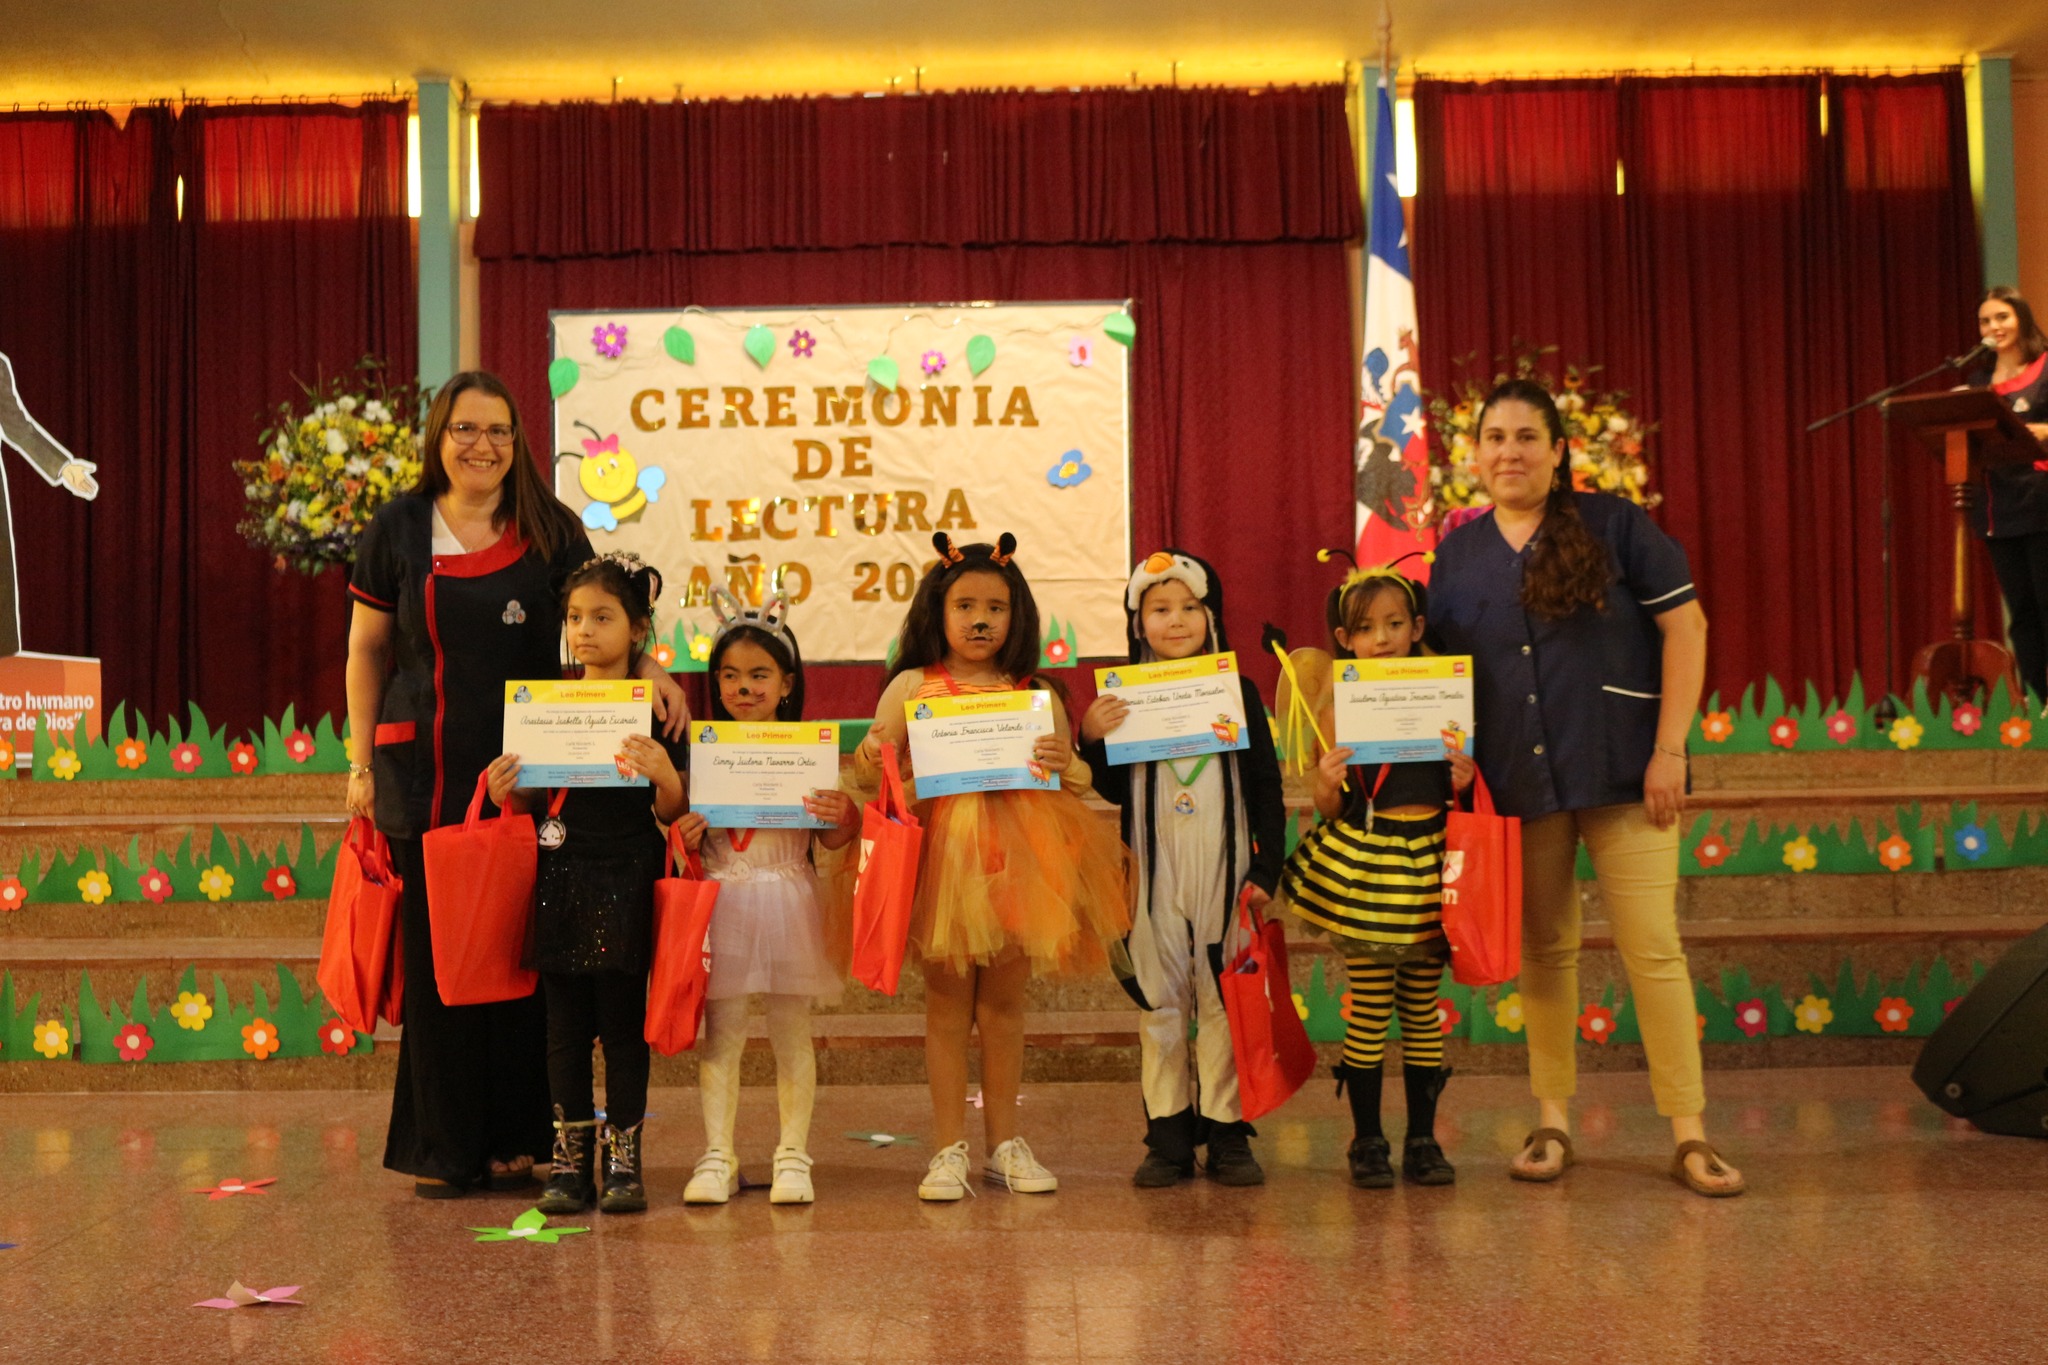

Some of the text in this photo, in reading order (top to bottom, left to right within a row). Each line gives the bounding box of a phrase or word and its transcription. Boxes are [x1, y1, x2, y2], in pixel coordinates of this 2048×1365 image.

[630, 385, 1039, 431] CEREMONIA
[793, 436, 873, 481] DE
[690, 488, 977, 542] LECTURA
[679, 553, 938, 607] AÑO 20
[16, 712, 36, 732] de
[25, 690, 94, 710] humano
